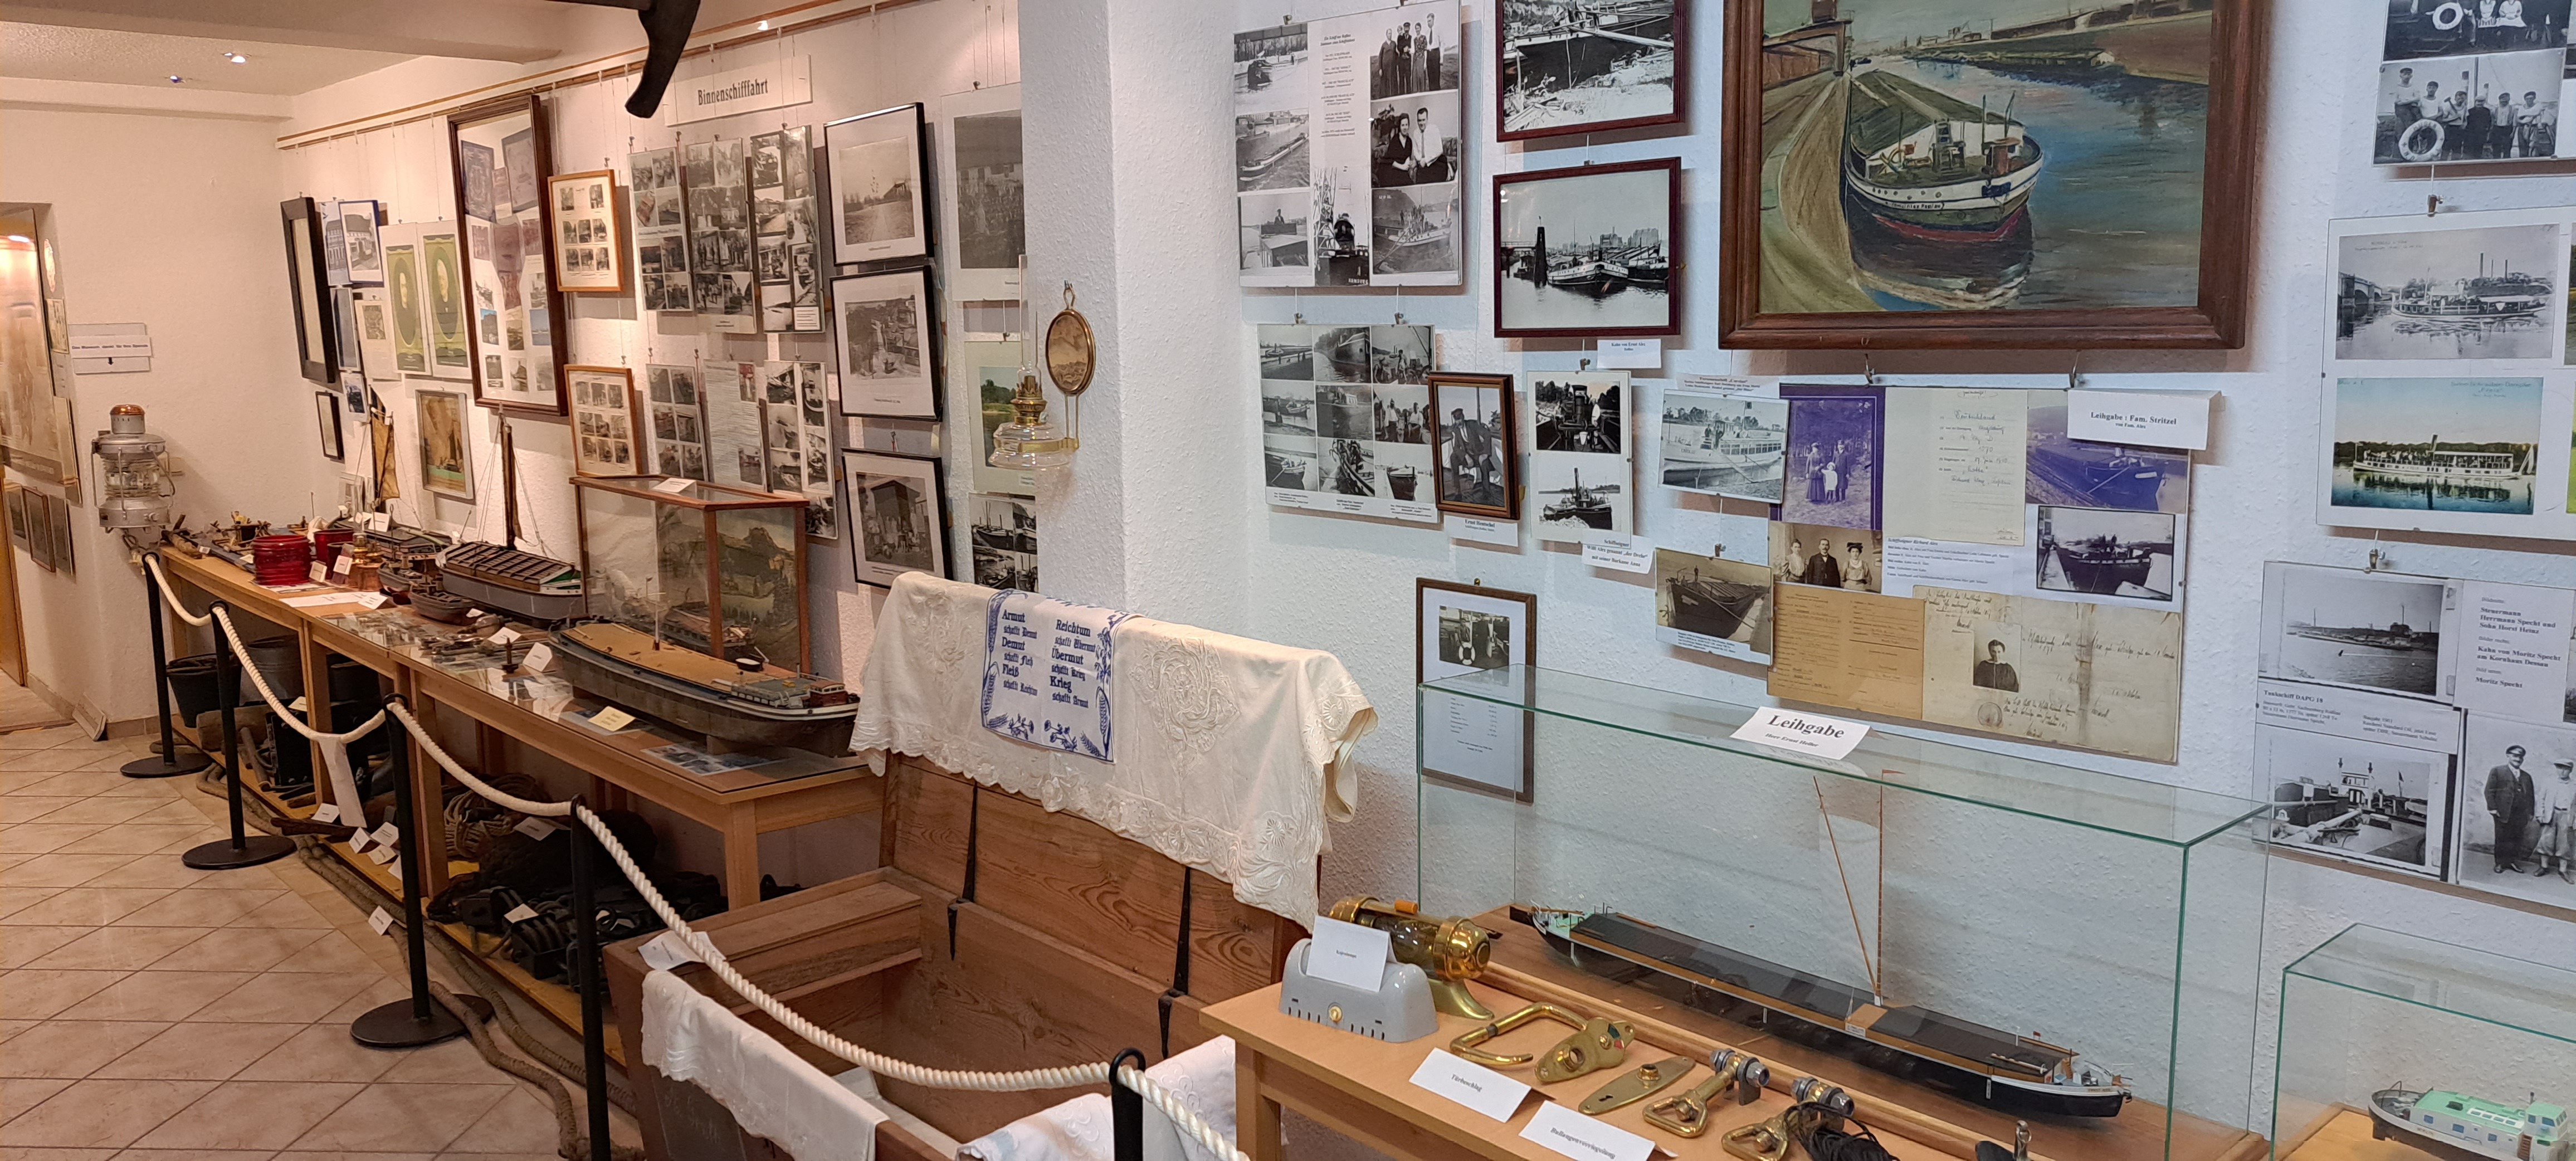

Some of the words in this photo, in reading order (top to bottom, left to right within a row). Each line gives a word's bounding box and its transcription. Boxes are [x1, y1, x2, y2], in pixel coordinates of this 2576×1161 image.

[698, 79, 768, 105] Binnenschifffahrt
[2091, 412, 2123, 421] Leihgabe
[2149, 416, 2177, 425] Stritzel
[1002, 609, 1025, 622] Armut
[2480, 615, 2515, 623] Herrmann
[2481, 607, 2521, 616] Steuermann
[1056, 619, 1091, 637] Reichtum
[1002, 636, 1025, 651] Demut
[1052, 645, 1084, 665] Übermut
[1002, 664, 1019, 677] Fleiß
[1050, 675, 1072, 693] Krieg
[1768, 714, 1845, 738] Leihgabe
